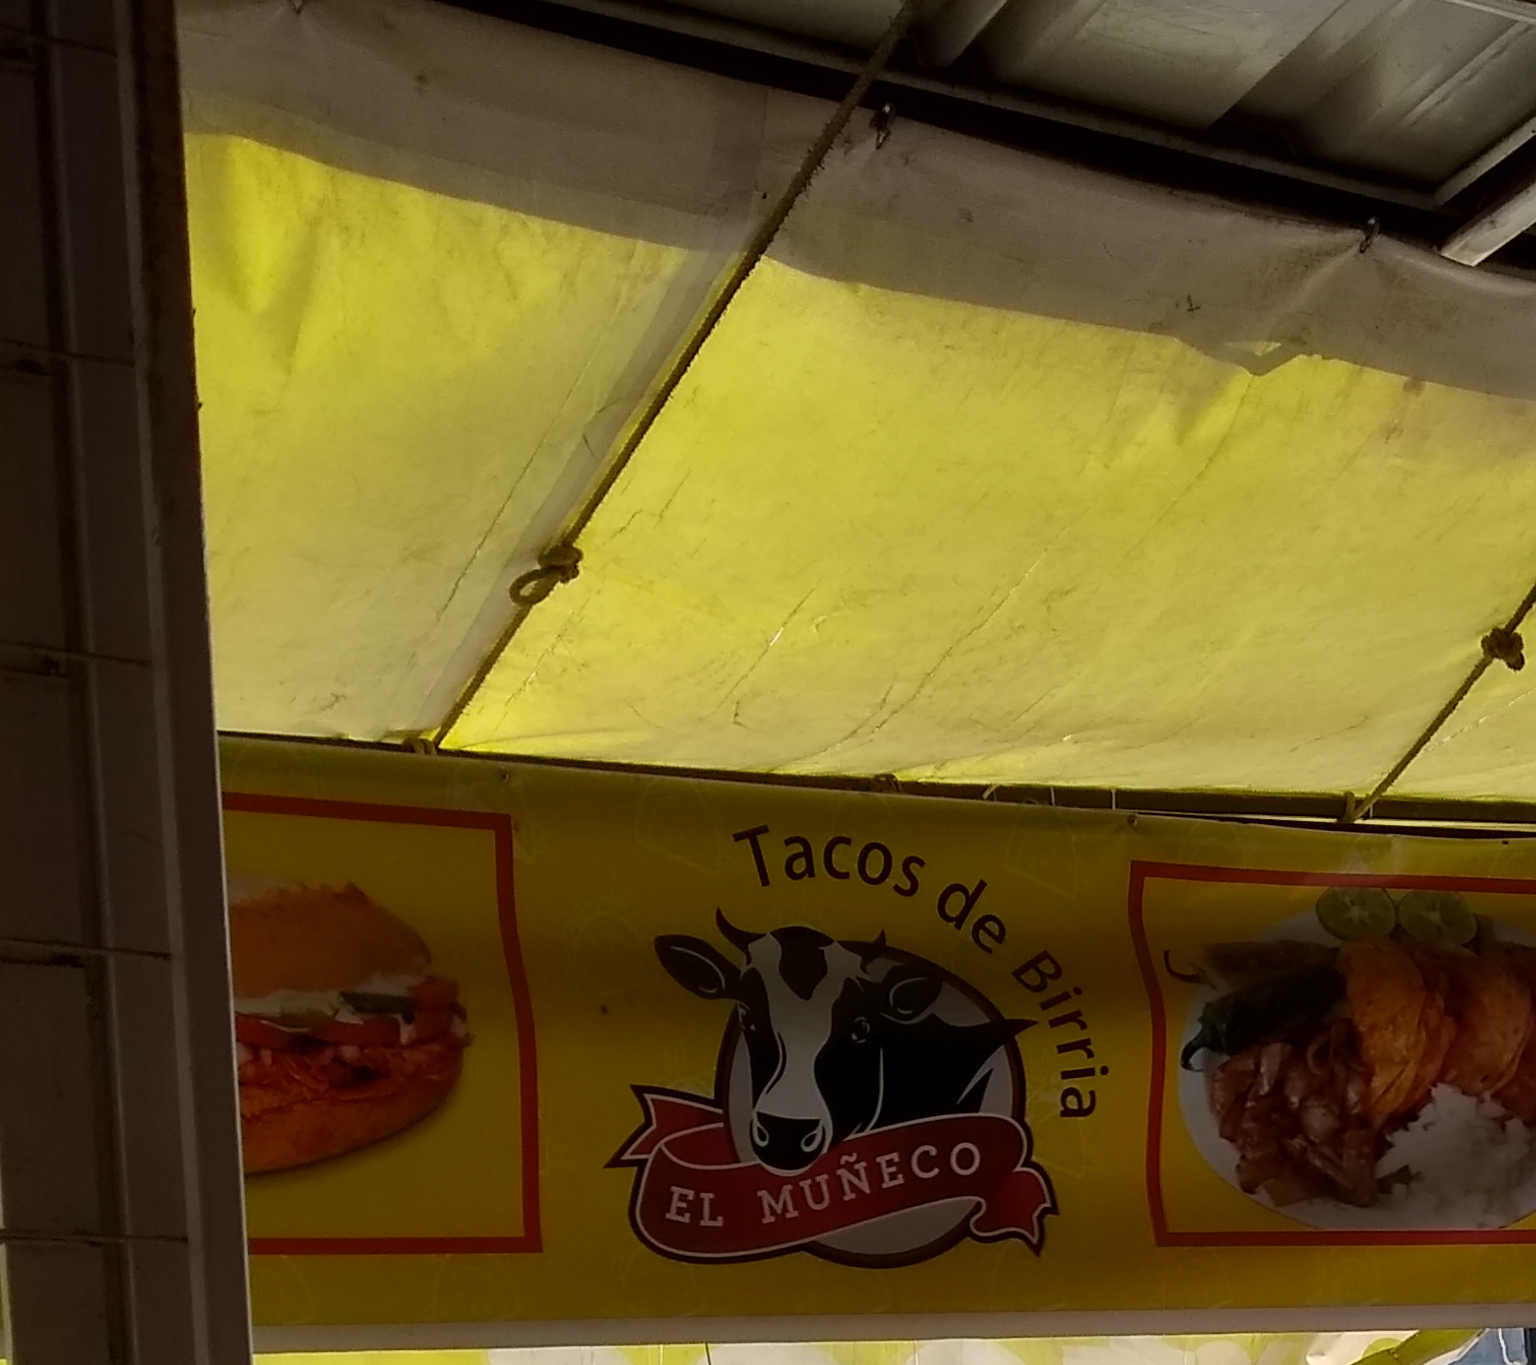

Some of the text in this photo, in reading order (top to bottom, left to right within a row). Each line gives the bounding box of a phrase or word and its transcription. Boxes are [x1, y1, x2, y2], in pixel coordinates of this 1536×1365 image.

[733, 825, 1110, 1118] Tacos de Birria
[665, 1142, 981, 1227] EL MUÑECO
